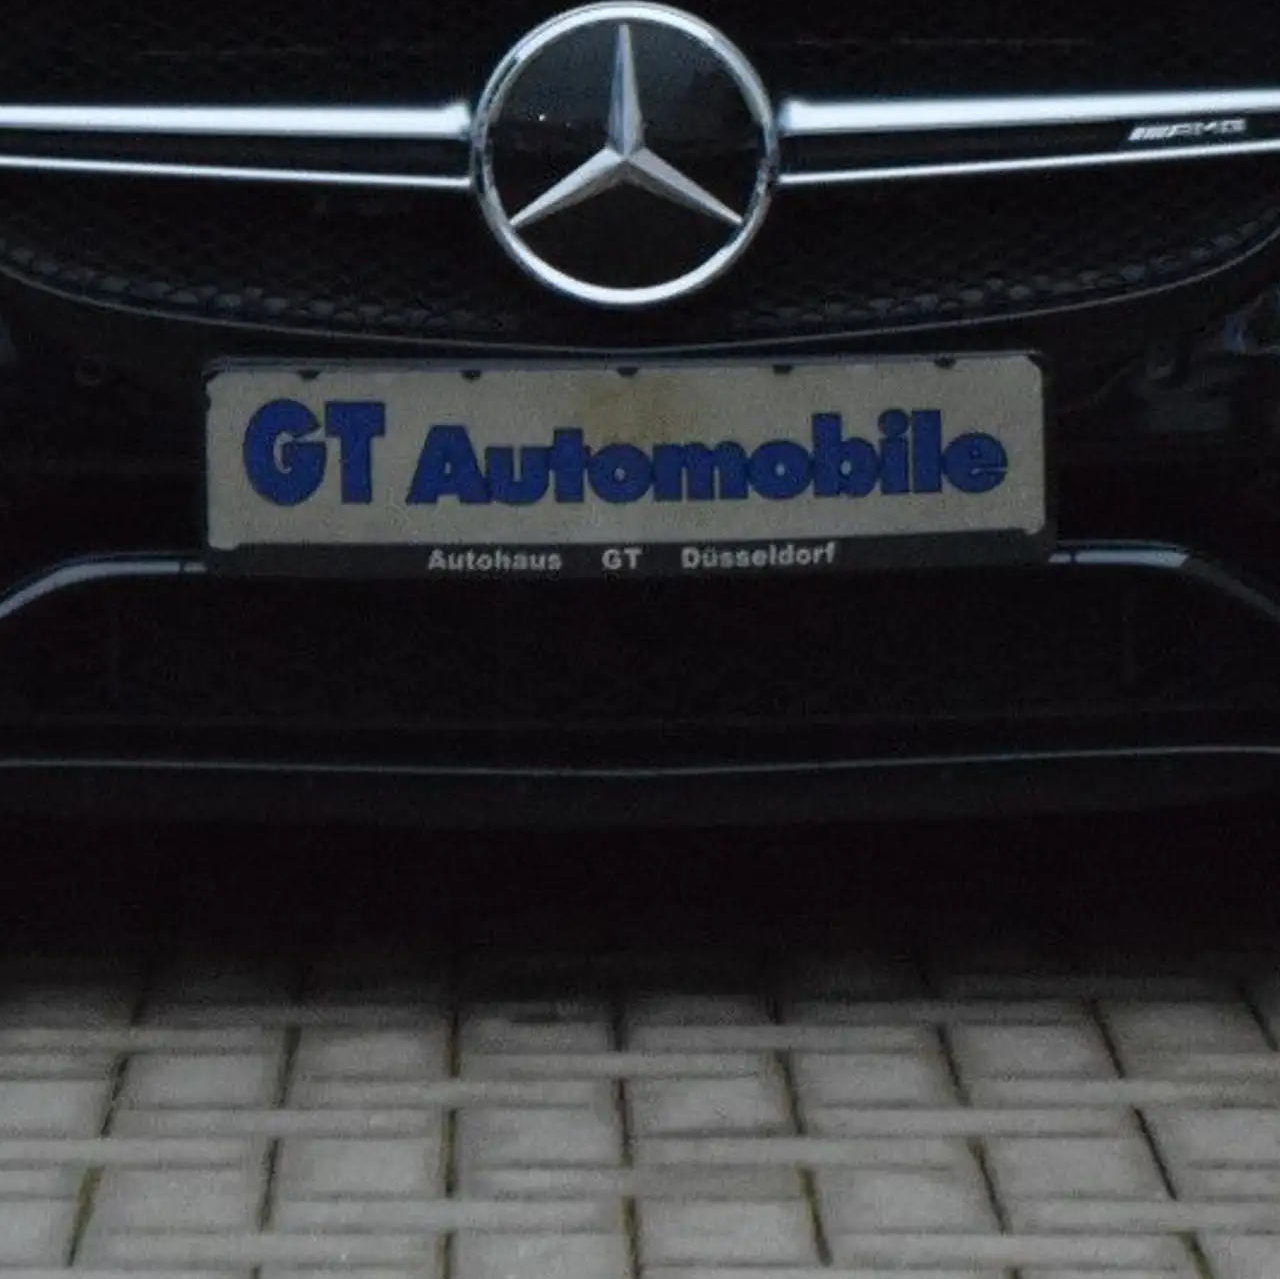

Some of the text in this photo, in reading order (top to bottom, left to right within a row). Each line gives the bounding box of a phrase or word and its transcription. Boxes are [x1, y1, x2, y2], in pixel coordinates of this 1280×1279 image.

[243, 399, 1008, 506] GT Automobile
[428, 542, 836, 571] Autohaus GT Düsseldorf
